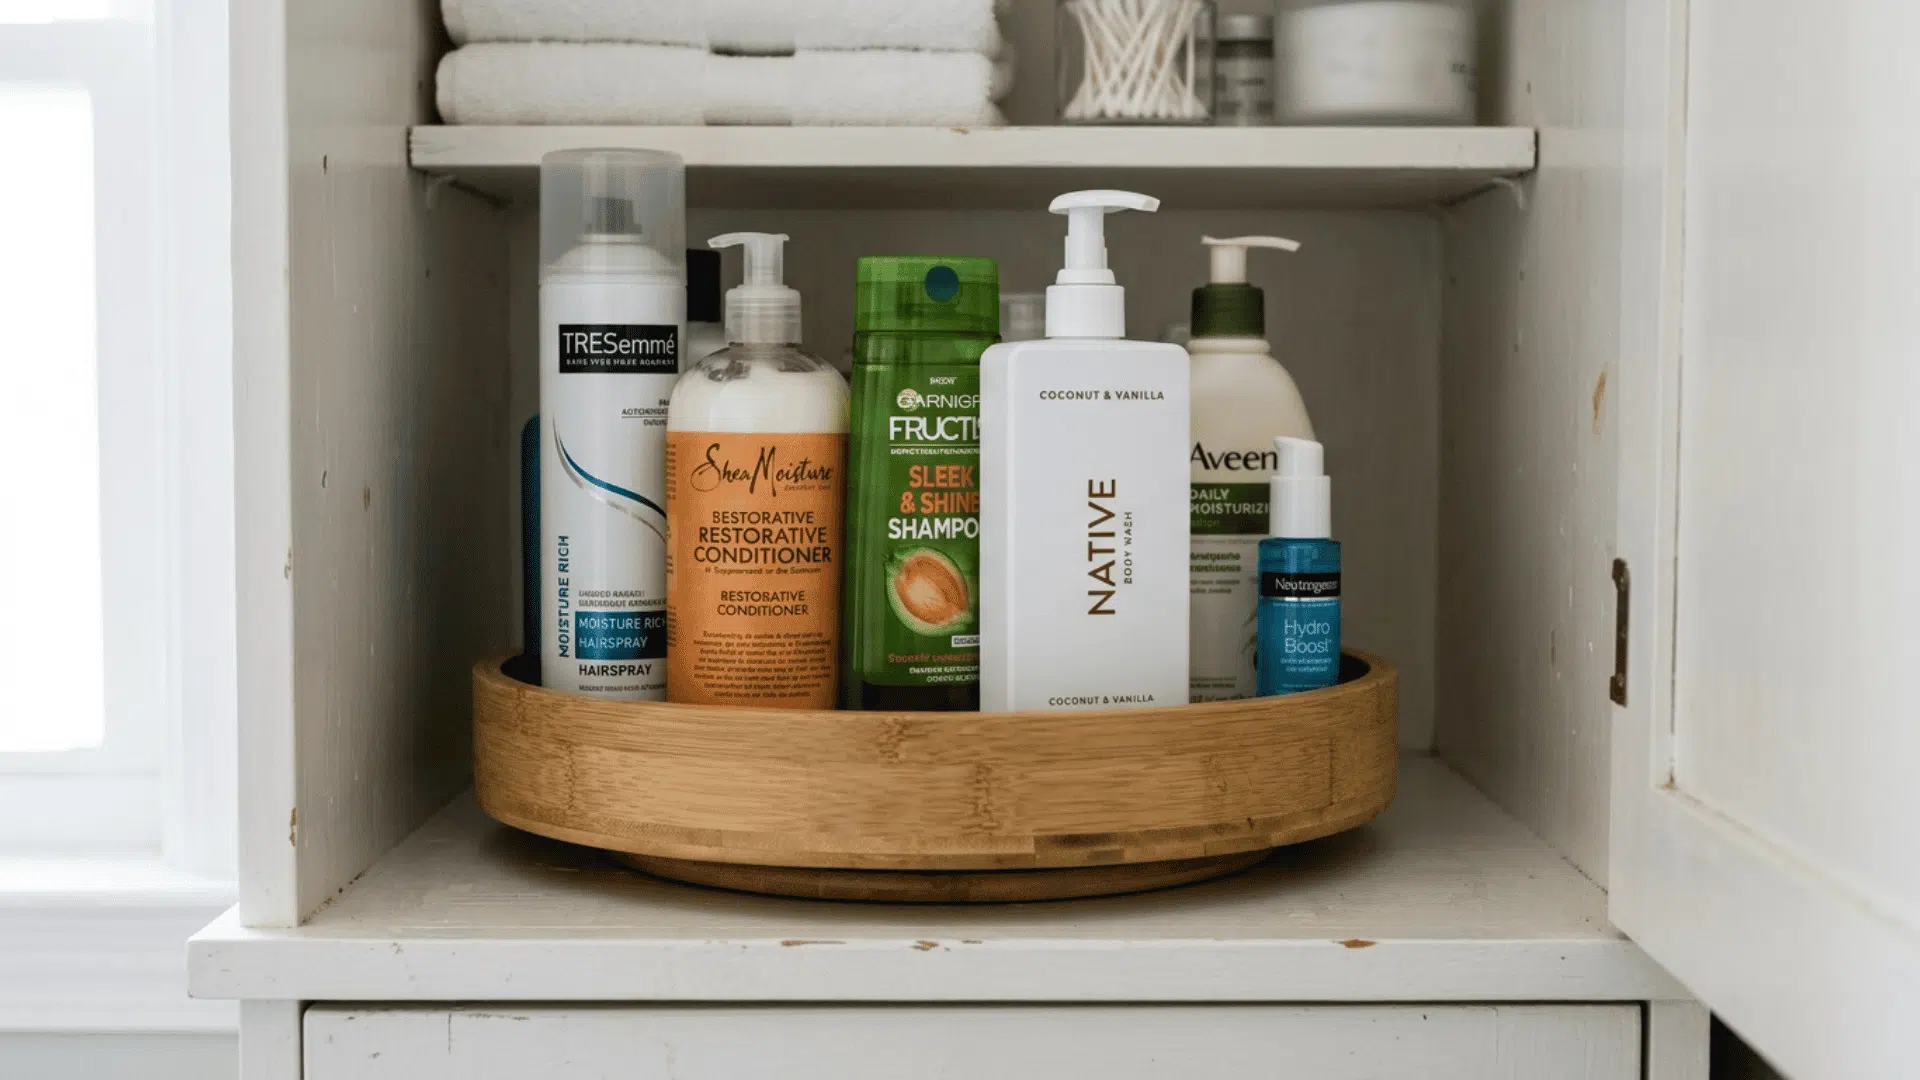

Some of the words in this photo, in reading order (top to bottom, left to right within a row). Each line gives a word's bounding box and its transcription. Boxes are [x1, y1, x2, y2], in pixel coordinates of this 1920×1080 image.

[562, 332, 675, 355] TRESemmé
[1039, 390, 1100, 400] COCONUT
[1103, 390, 1112, 400] &
[1115, 390, 1165, 400] VANILLA
[909, 464, 975, 489] SLEEK
[900, 491, 916, 514] &
[920, 491, 980, 514] SHINE
[699, 527, 827, 544] RESTORATIVE
[1124, 511, 1133, 546] WASH
[558, 535, 570, 573] RICH
[694, 546, 833, 564] CONDITIONER
[1088, 479, 1116, 615] NATIVE
[1124, 551, 1133, 584] BODY
[558, 577, 570, 658] MOISTURE
[717, 604, 809, 616] CONDITIONER
[579, 618, 641, 630] MOISTURE
[1284, 620, 1330, 638] Hydro
[579, 637, 648, 649] HAIRSPRAY
[579, 664, 653, 677] HAIRSPRAY
[1049, 696, 1099, 706] COCONUT
[1112, 694, 1155, 703] VANILLA
